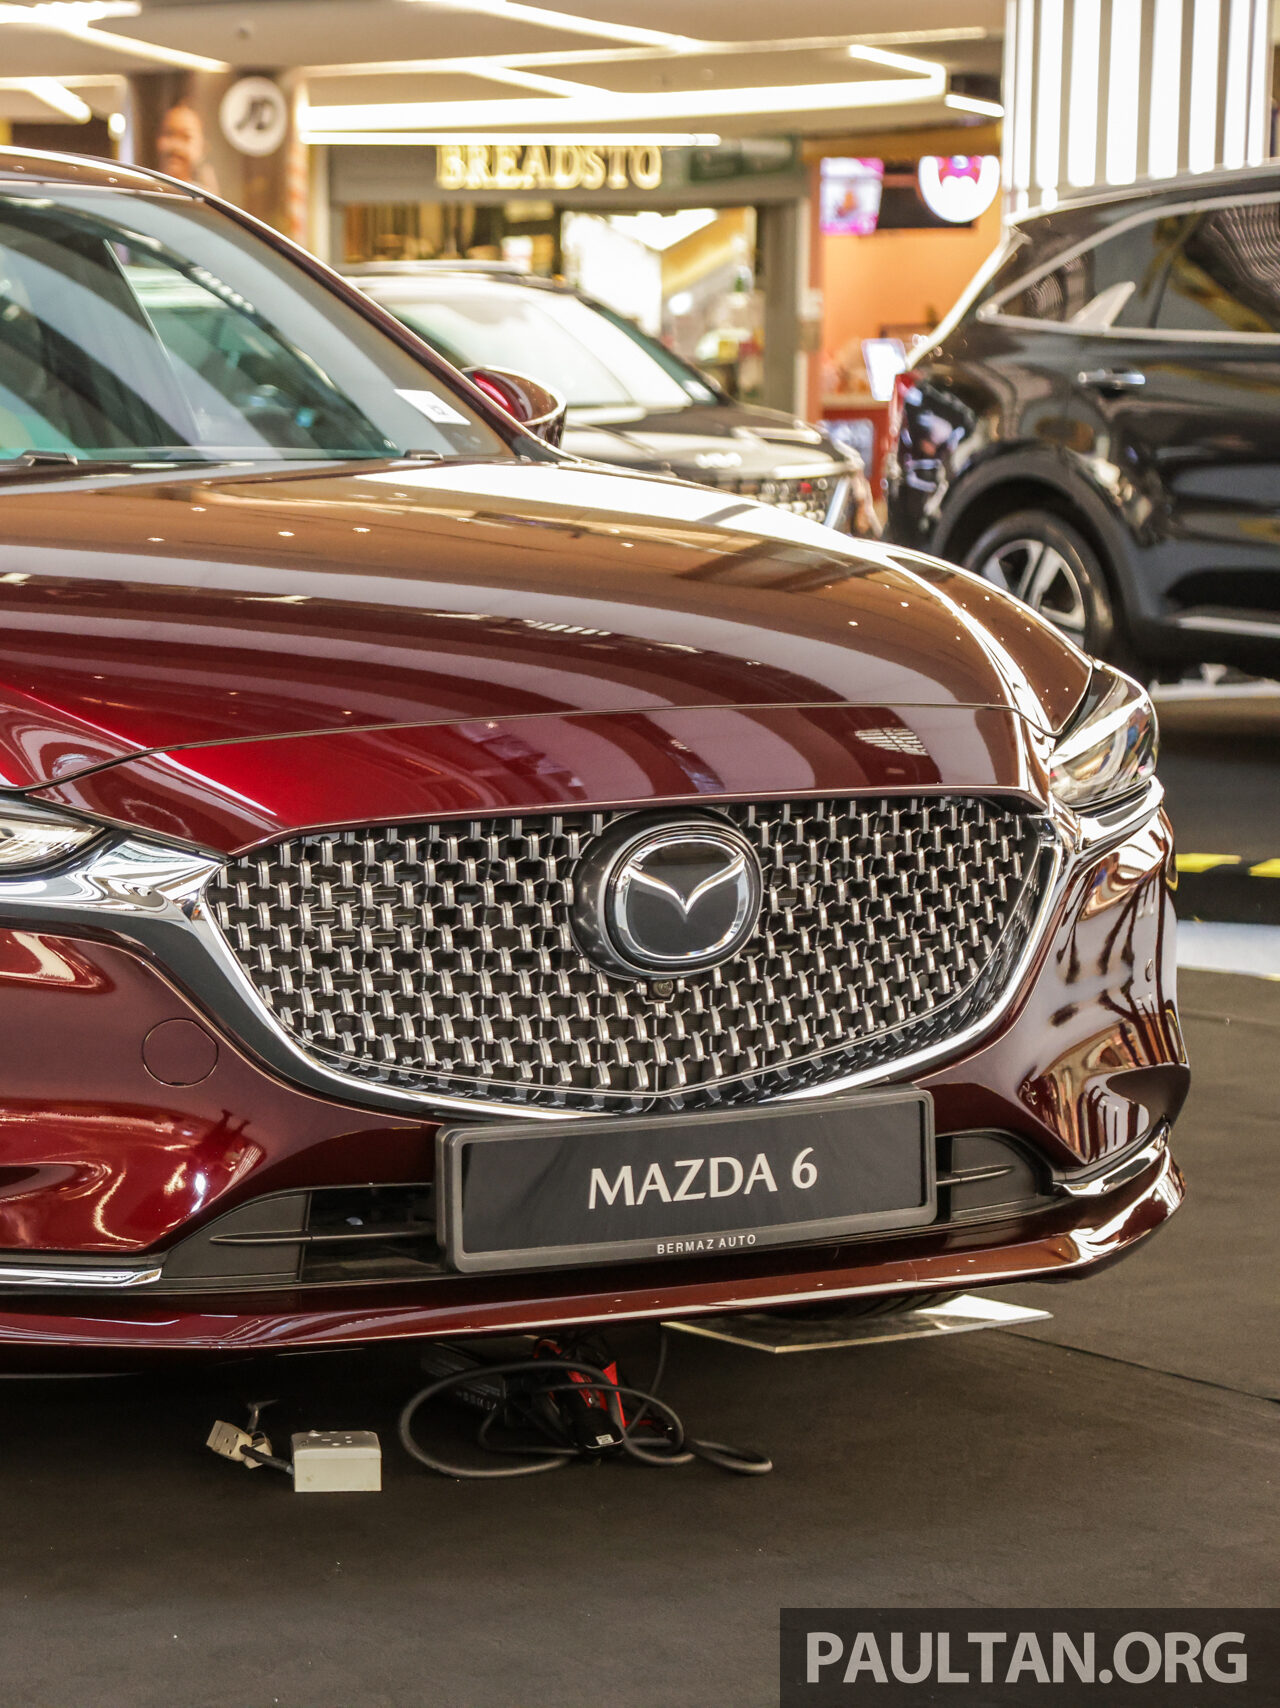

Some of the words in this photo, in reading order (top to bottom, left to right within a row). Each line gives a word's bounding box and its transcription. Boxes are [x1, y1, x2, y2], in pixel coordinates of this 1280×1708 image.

[587, 1152, 778, 1210] MAZDA
[791, 1146, 819, 1190] 6
[656, 1239, 715, 1255] BERMAZ
[718, 1233, 757, 1249] AUTO
